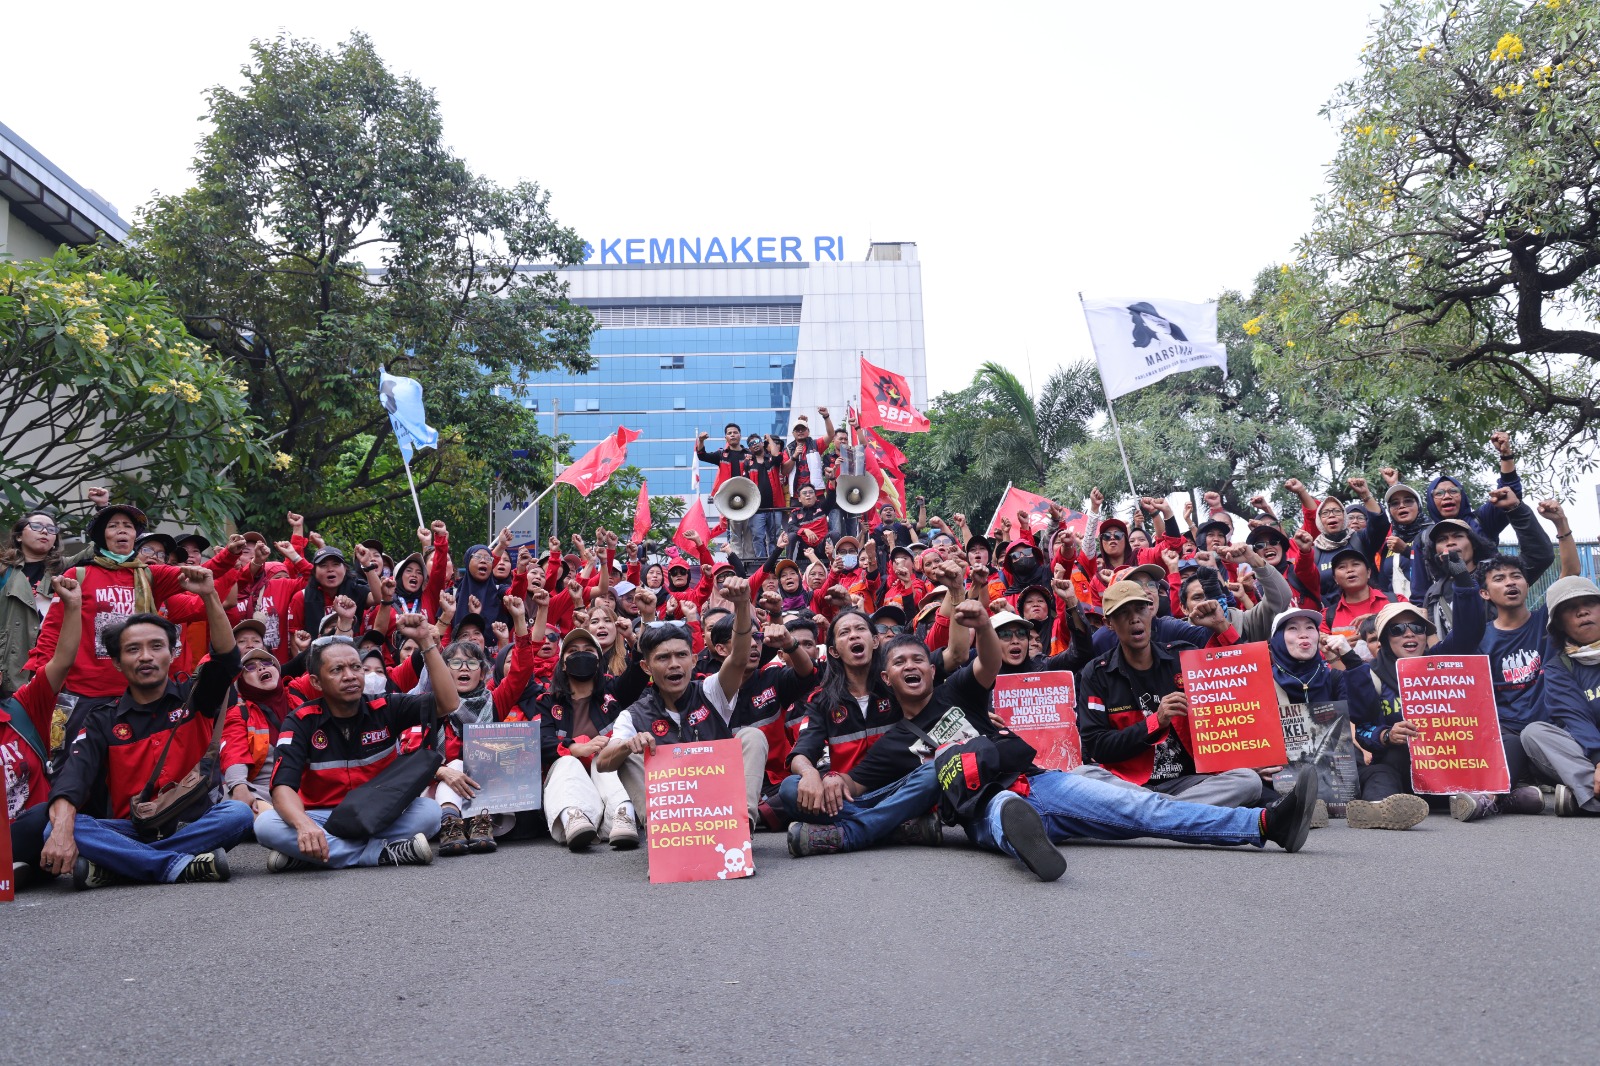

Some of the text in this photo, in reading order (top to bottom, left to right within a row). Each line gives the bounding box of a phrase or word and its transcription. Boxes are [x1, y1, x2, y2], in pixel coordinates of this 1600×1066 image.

[600, 236, 844, 264] KEMNAKER RI
[877, 404, 914, 424] SBPI
[502, 502, 530, 511] AM
[95, 588, 136, 603] MAYD
[1220, 649, 1242, 657] KPBI
[1187, 663, 1258, 680] BAYARKAN
[1188, 677, 1247, 692] JAMINAN
[1402, 675, 1475, 688] BAYARKAN
[998, 685, 1069, 700] NASIONALISASI
[1190, 691, 1236, 705] SOSIAL
[1404, 689, 1466, 701] JAMINAN
[999, 694, 1069, 709] DAN HILIRISASI
[1012, 705, 1056, 716] INDUSTRI
[1191, 701, 1260, 717] 133 BURUH
[1279, 704, 1302, 718] LAK!
[1406, 703, 1456, 715] SOSIAL
[933, 709, 962, 740] BELAJAR
[1010, 713, 1060, 725] STRATEGIS
[1194, 714, 1255, 729] PT. AMOS
[1431, 716, 1479, 728] BURUH
[1196, 728, 1238, 742] INDAH
[1283, 724, 1308, 737] KEL
[1433, 730, 1474, 741] AMOS
[691, 746, 714, 754] KPBI
[1197, 738, 1271, 755] INDONESIA
[1412, 745, 1457, 756] INDAH
[1415, 758, 1490, 770] INDONESIA
[648, 765, 725, 780] HAPUSKAN
[648, 780, 698, 794] SISTEM
[649, 794, 695, 807] KERJA
[650, 805, 733, 820] KEMITRAAN
[651, 818, 738, 834] PADA SOPIR
[652, 834, 717, 848] LOGISTIK
